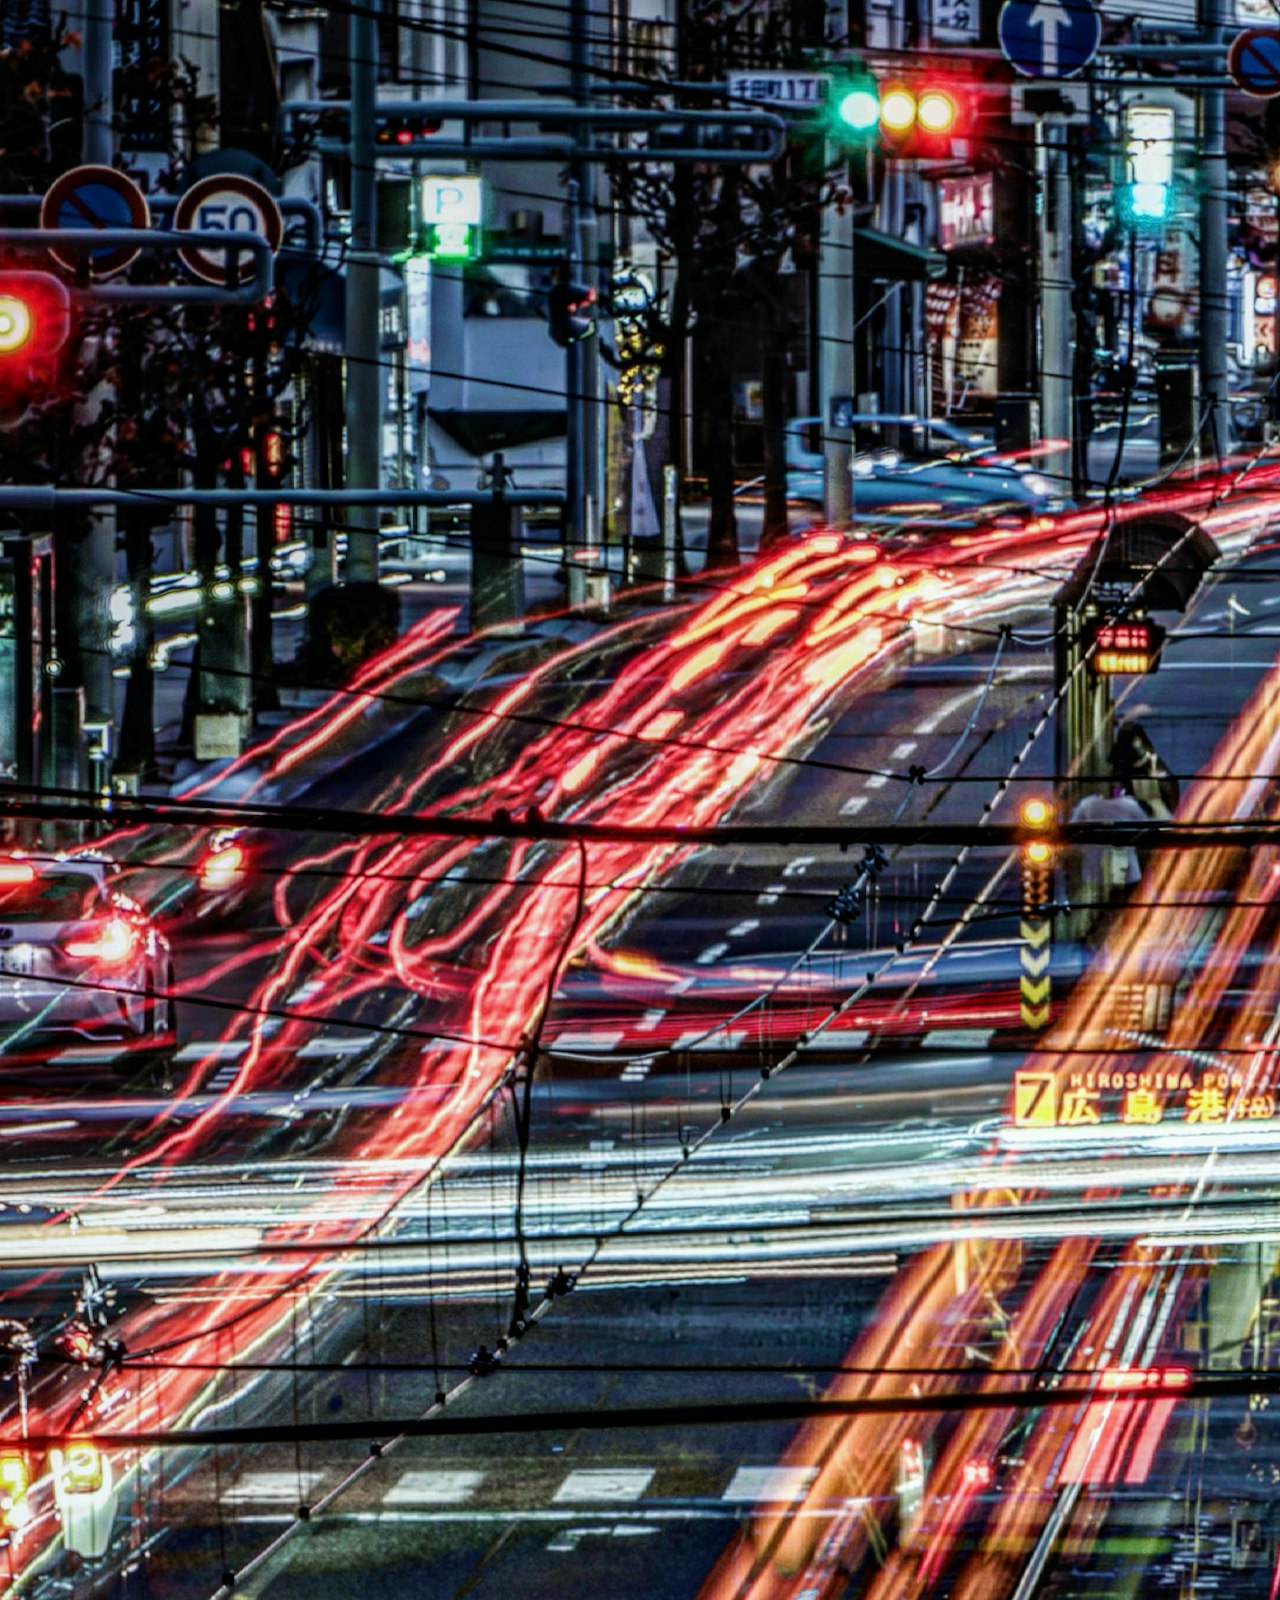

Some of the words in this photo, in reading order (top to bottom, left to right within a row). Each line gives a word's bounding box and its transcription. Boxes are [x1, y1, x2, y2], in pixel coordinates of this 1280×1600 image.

[435, 187, 463, 215] P
[1019, 1078, 1050, 1120] 7
[1070, 1073, 1194, 1089] HIROSHIMA
